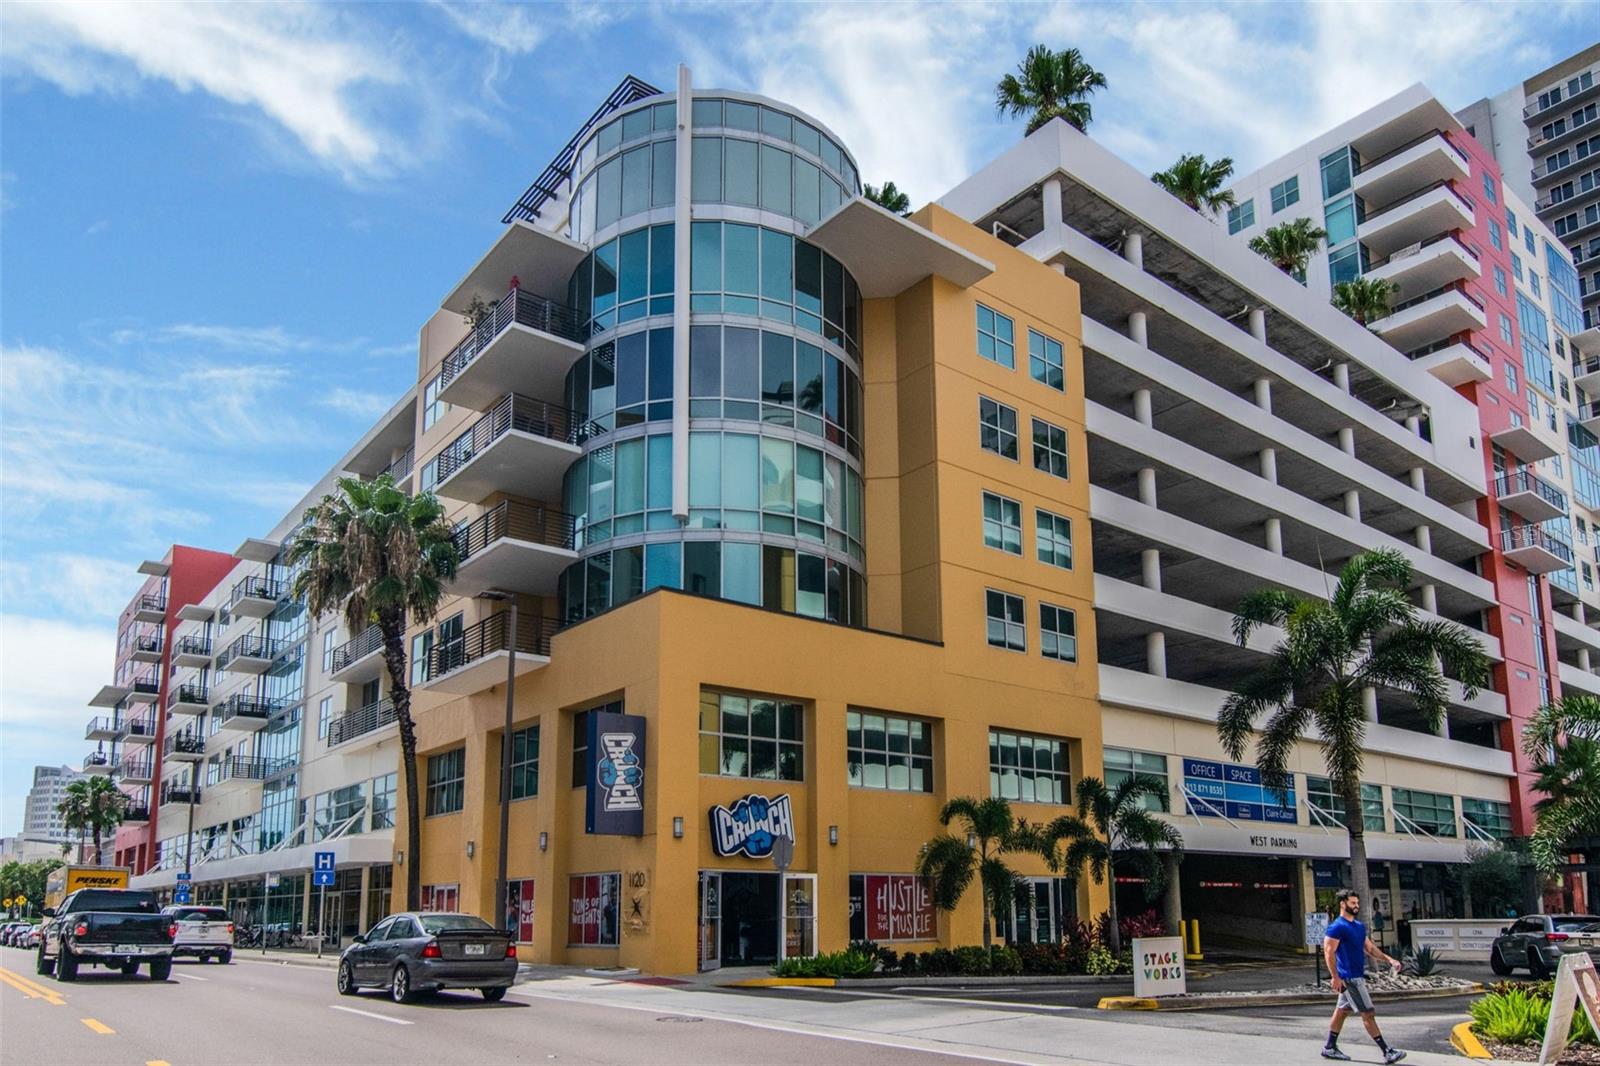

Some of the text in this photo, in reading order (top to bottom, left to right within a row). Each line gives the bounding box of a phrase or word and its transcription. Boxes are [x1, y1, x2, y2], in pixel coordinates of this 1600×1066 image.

[603, 735, 640, 809] CRUNCH
[1190, 763, 1252, 782] OFFICE SPACE
[718, 798, 793, 853] CRUNCH
[1250, 835, 1298, 848] WEST PARKING
[318, 854, 331, 869] H
[629, 872, 645, 888] 1120
[876, 879, 931, 914] HUSTLE
[890, 913, 932, 935] MUSCLE
[1143, 952, 1178, 966] STAGE
[1143, 966, 1181, 980] WORKS
